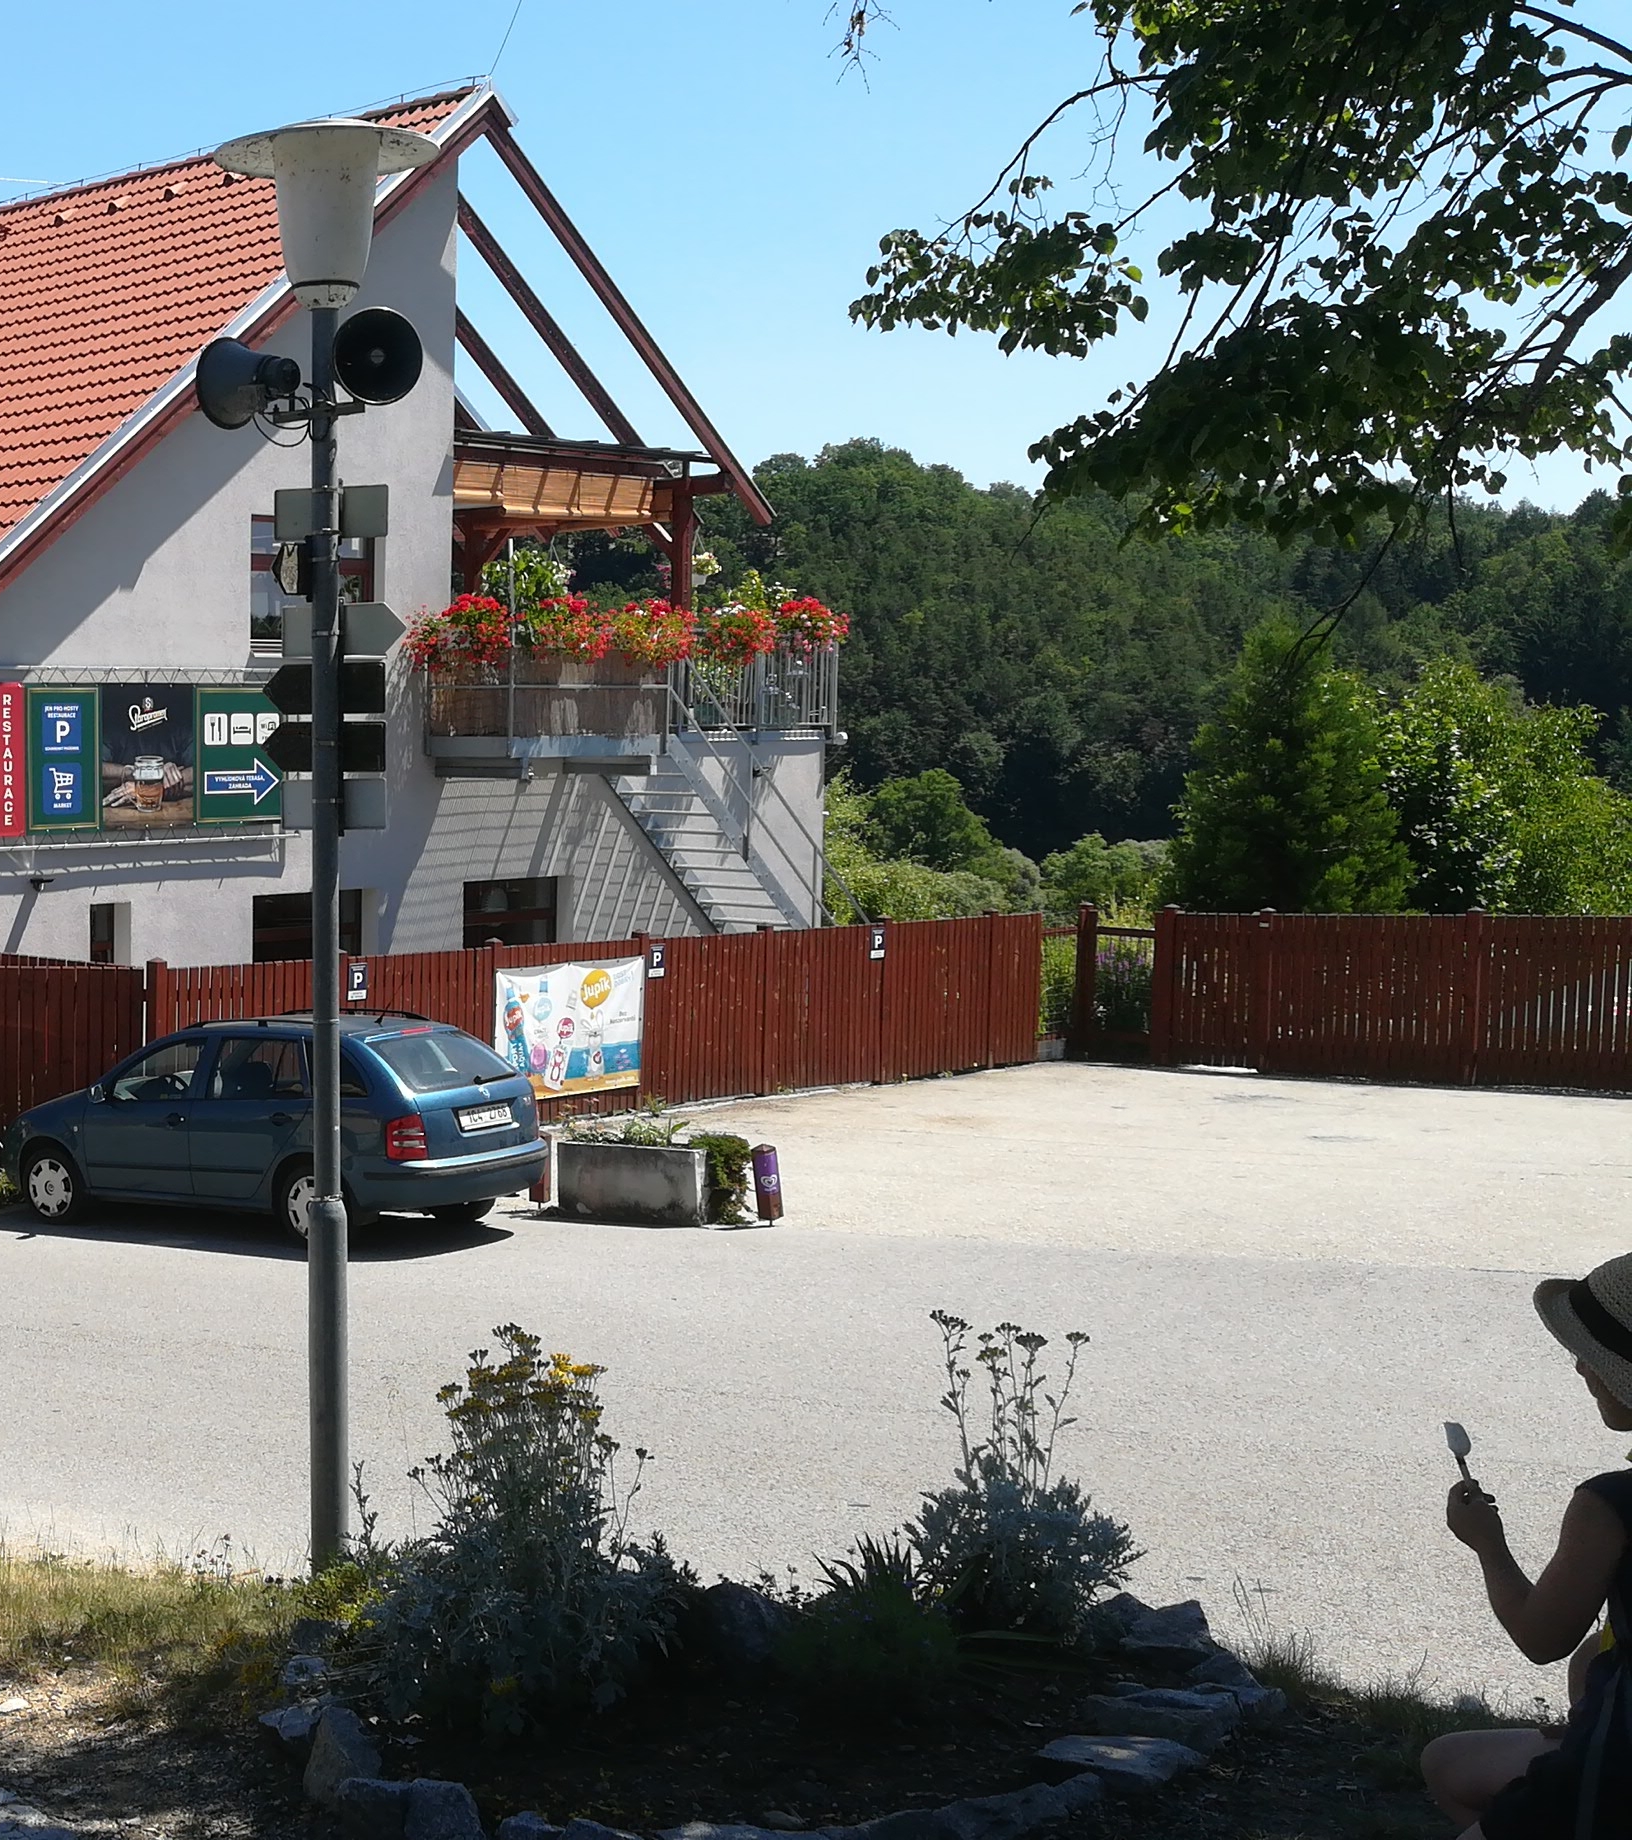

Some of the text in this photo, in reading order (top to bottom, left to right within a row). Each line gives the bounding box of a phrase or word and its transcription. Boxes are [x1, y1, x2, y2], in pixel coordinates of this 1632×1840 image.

[56, 720, 70, 743] P
[2, 694, 14, 826] RESTAURACE
[874, 935, 883, 949] P
[653, 952, 662, 967] P
[353, 972, 364, 989] P
